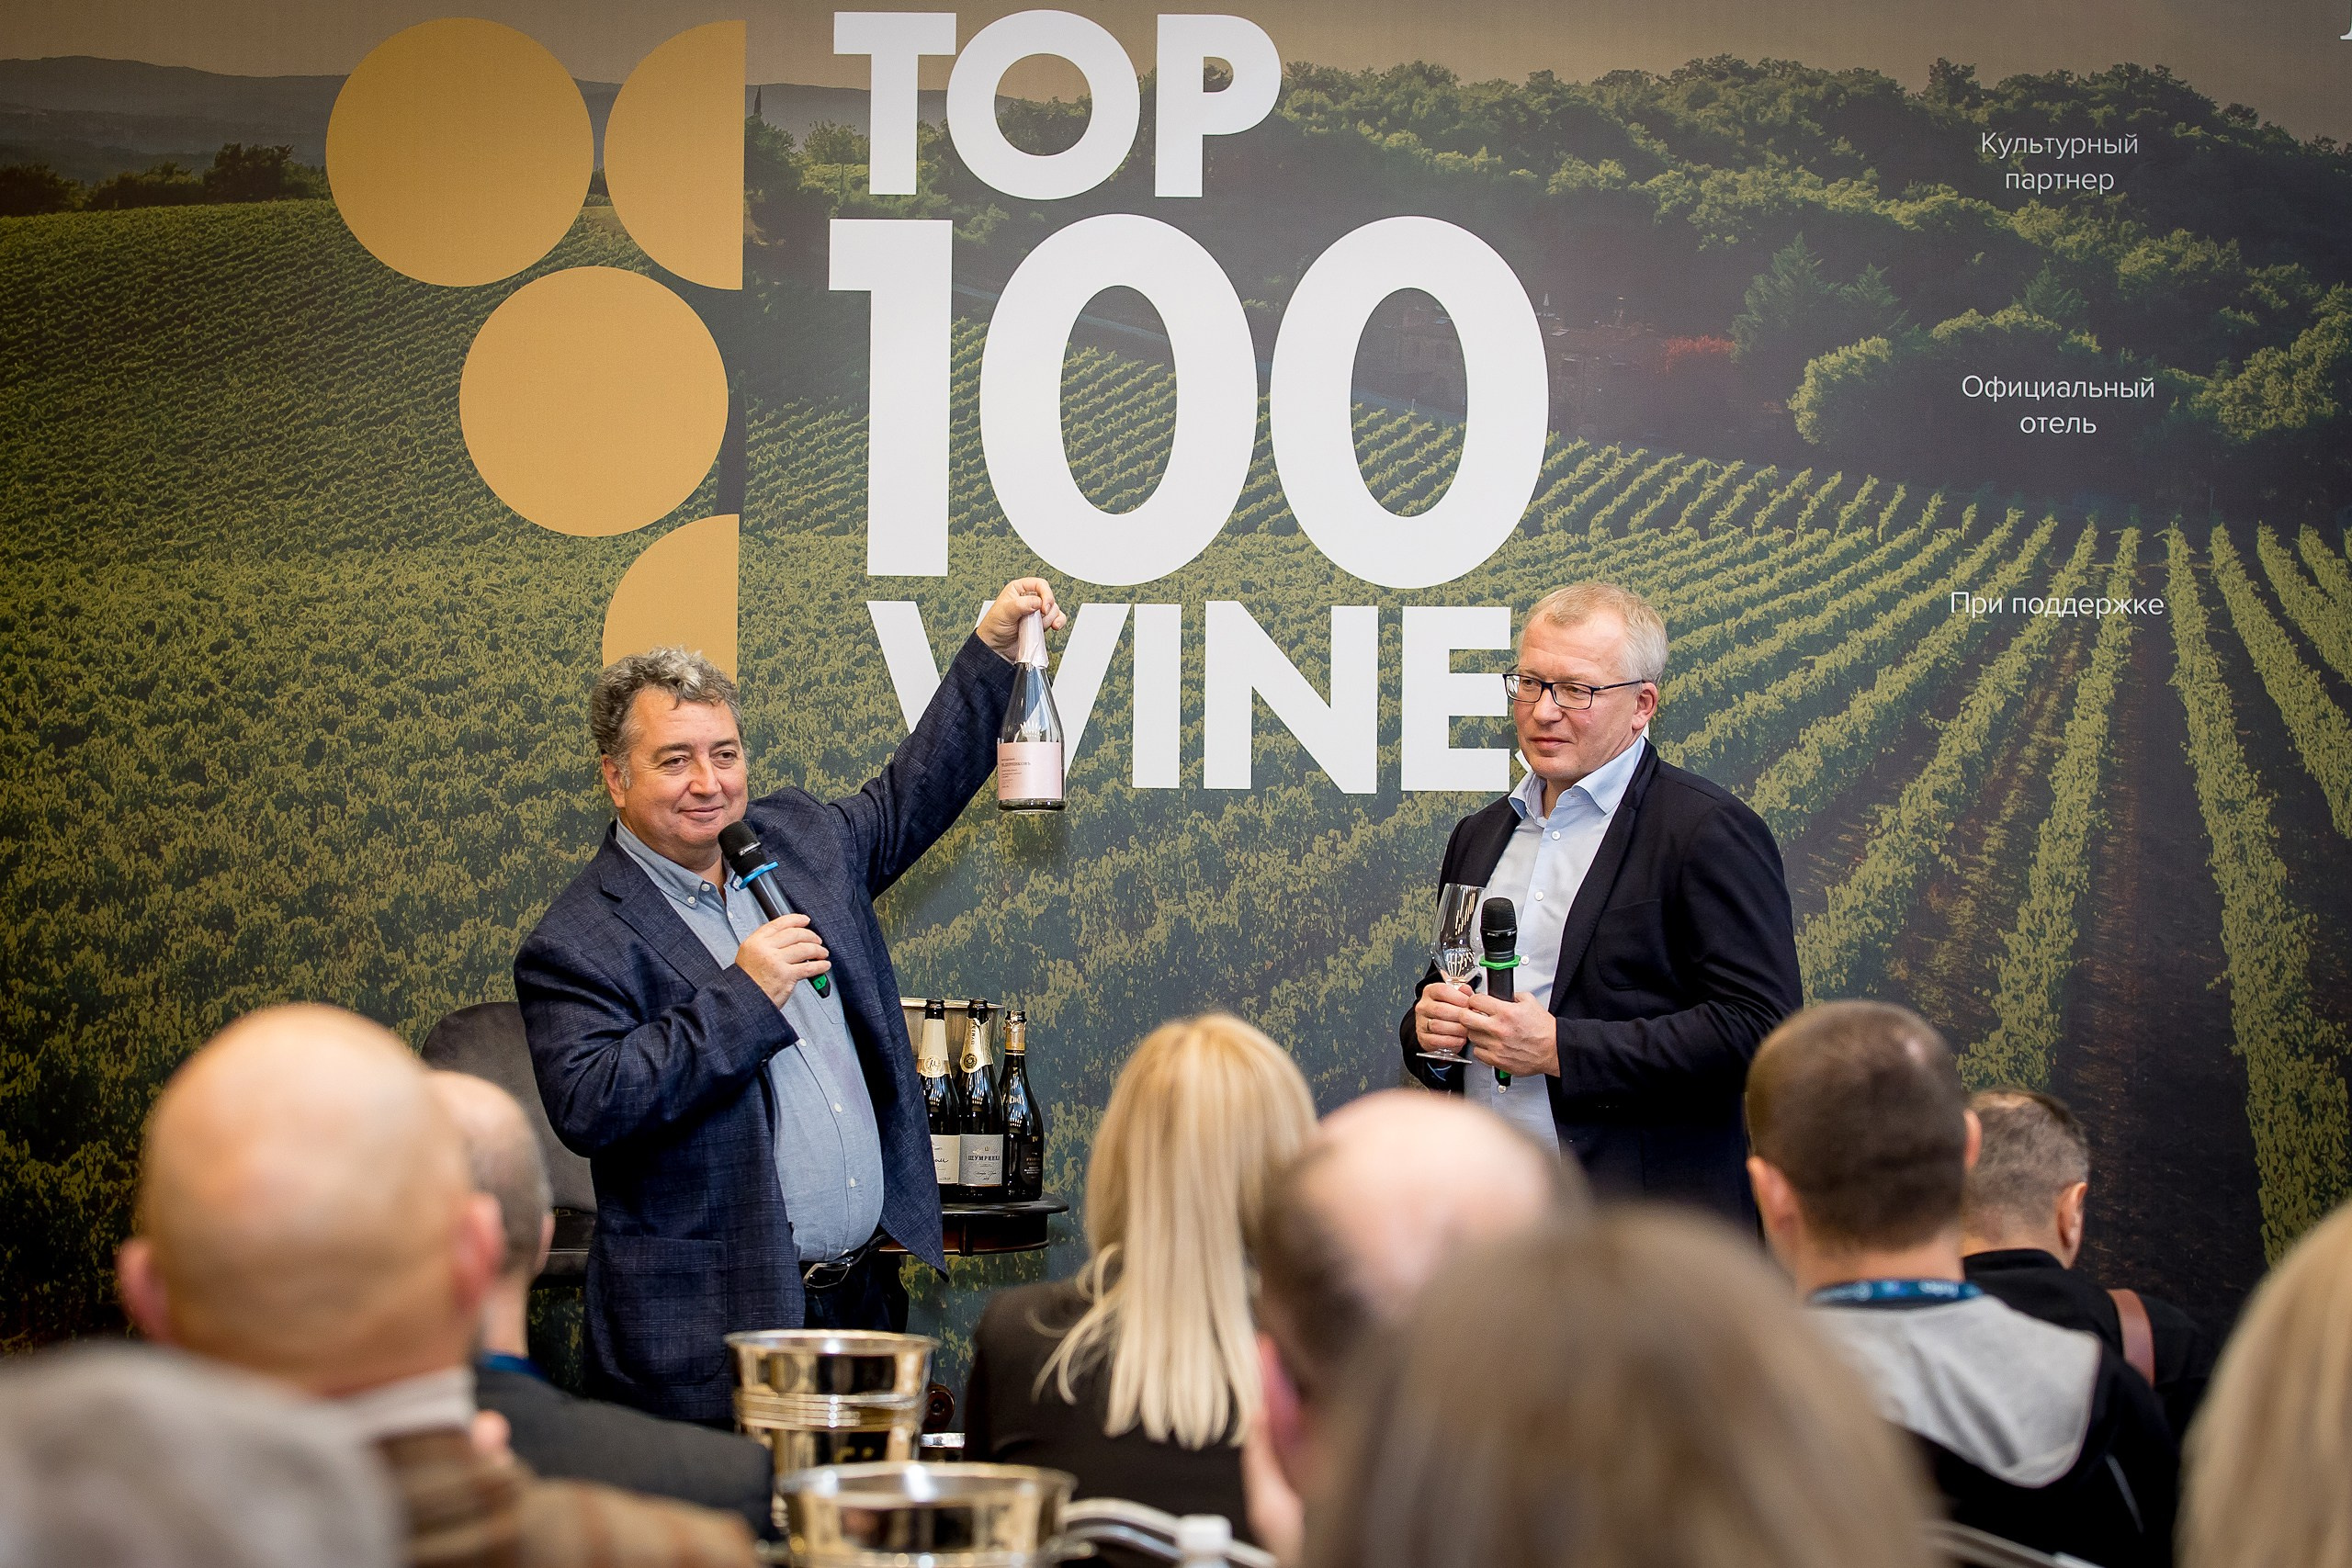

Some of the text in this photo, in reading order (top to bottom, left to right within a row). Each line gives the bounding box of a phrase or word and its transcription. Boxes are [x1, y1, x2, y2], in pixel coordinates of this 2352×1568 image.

[833, 9, 1283, 200] TOP
[1982, 130, 2139, 160] Культурный
[2006, 173, 2116, 196] партнер
[828, 213, 1550, 590] 100
[1962, 374, 2155, 403] Официальный
[2019, 416, 2098, 434] отель
[1948, 591, 2165, 620] При поддержке
